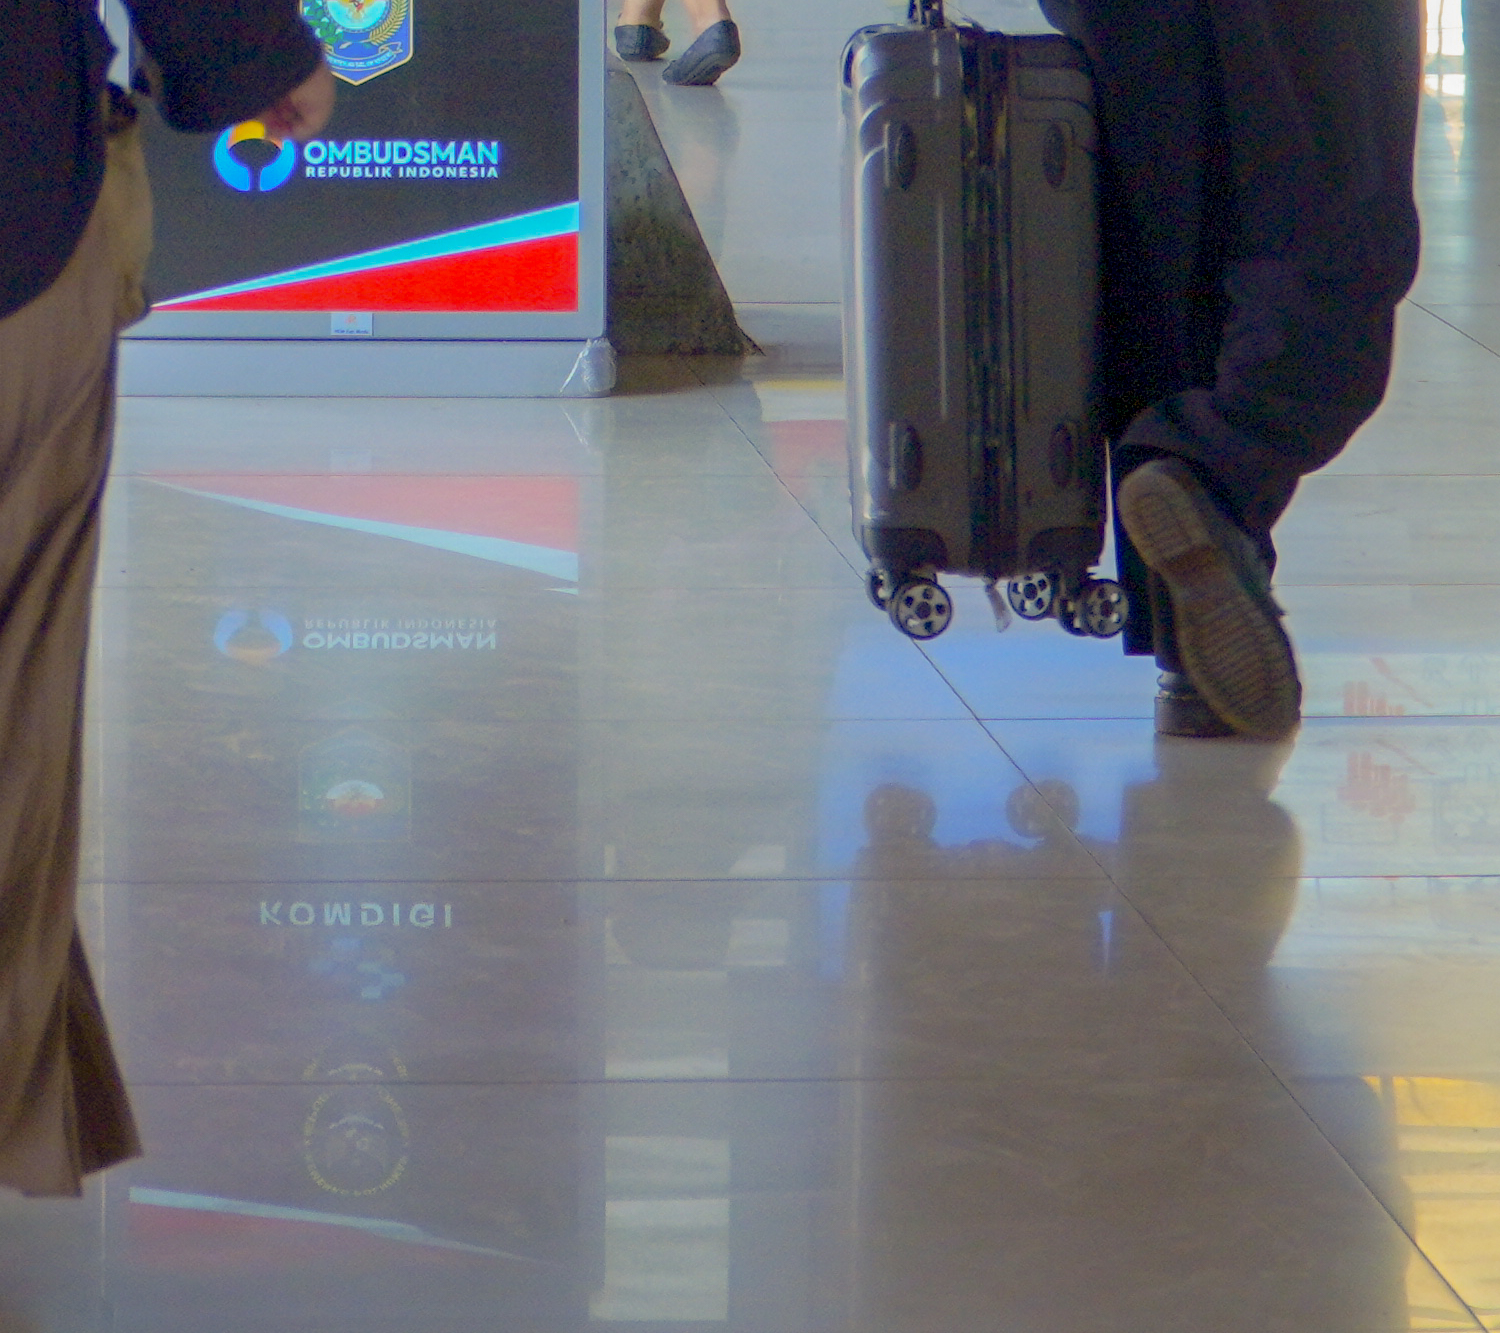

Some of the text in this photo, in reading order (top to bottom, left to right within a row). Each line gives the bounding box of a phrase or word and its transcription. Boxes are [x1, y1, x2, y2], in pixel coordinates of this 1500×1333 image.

[303, 140, 499, 165] OMBUDSMAN
[305, 167, 499, 179] REPUBLIK INDONESIA
